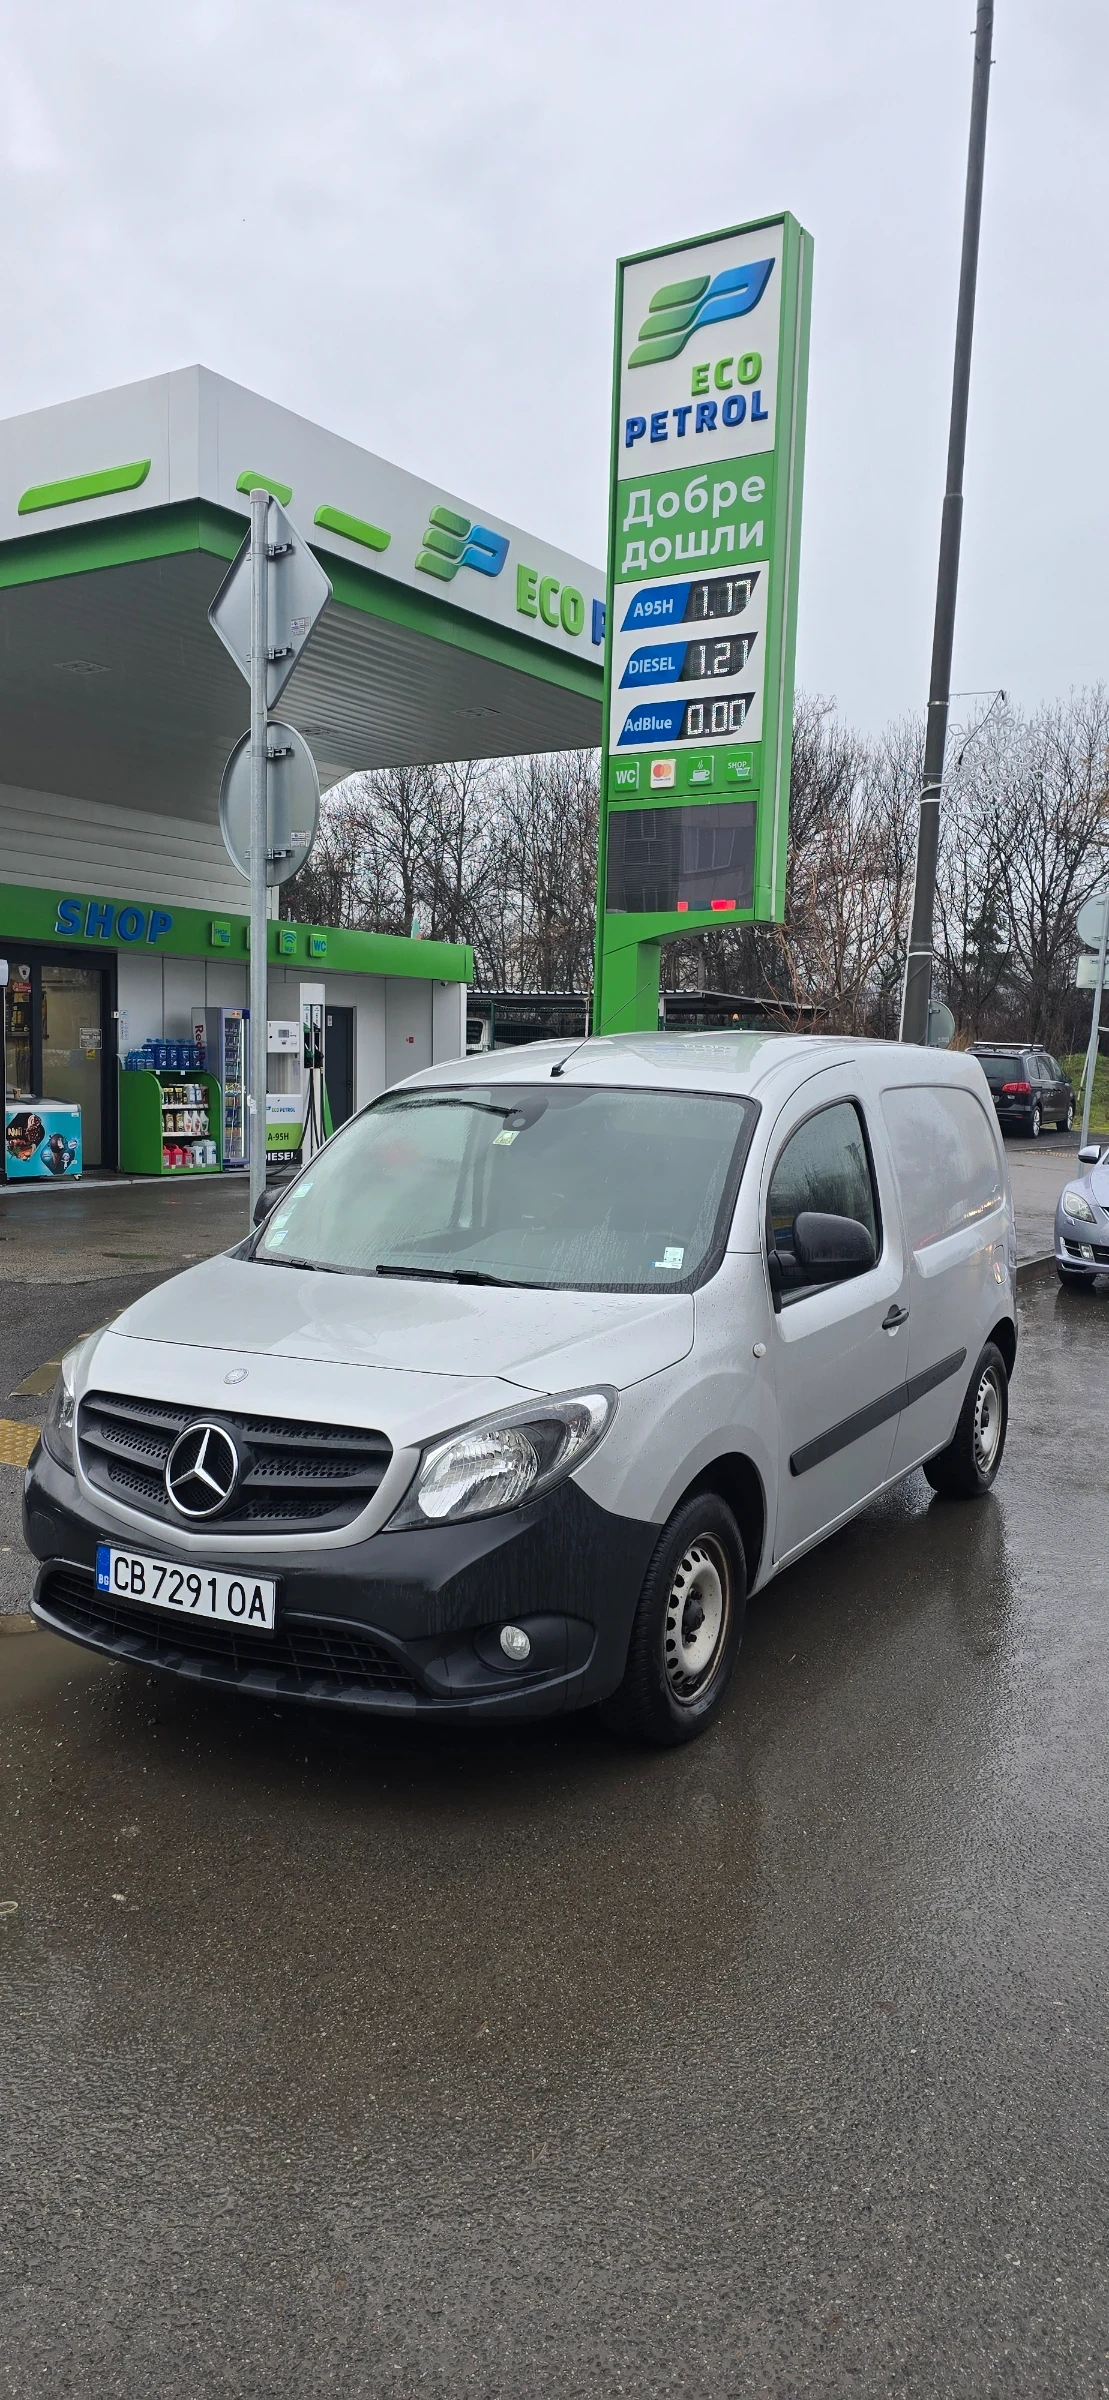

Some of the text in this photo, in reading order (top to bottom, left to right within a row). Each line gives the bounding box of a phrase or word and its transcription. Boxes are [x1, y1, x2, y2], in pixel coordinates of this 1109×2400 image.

[691, 351, 763, 396] ECO
[625, 390, 768, 448] PETROL
[623, 475, 766, 532] Добре
[621, 520, 764, 574] дошли
[516, 562, 585, 637] ECO
[633, 598, 674, 617] A95H
[628, 656, 676, 675] DIESEL
[624, 716, 673, 733] AdBlue
[686, 698, 746, 735] 0.00
[728, 760, 747, 770] SHOP
[616, 769, 636, 785] WC
[55, 899, 173, 944] SHOP
[313, 939, 327, 952] WC
[267, 1132, 290, 1141] A-95H
[265, 1151, 297, 1161] IESEL
[98, 1573, 109, 1586] BG
